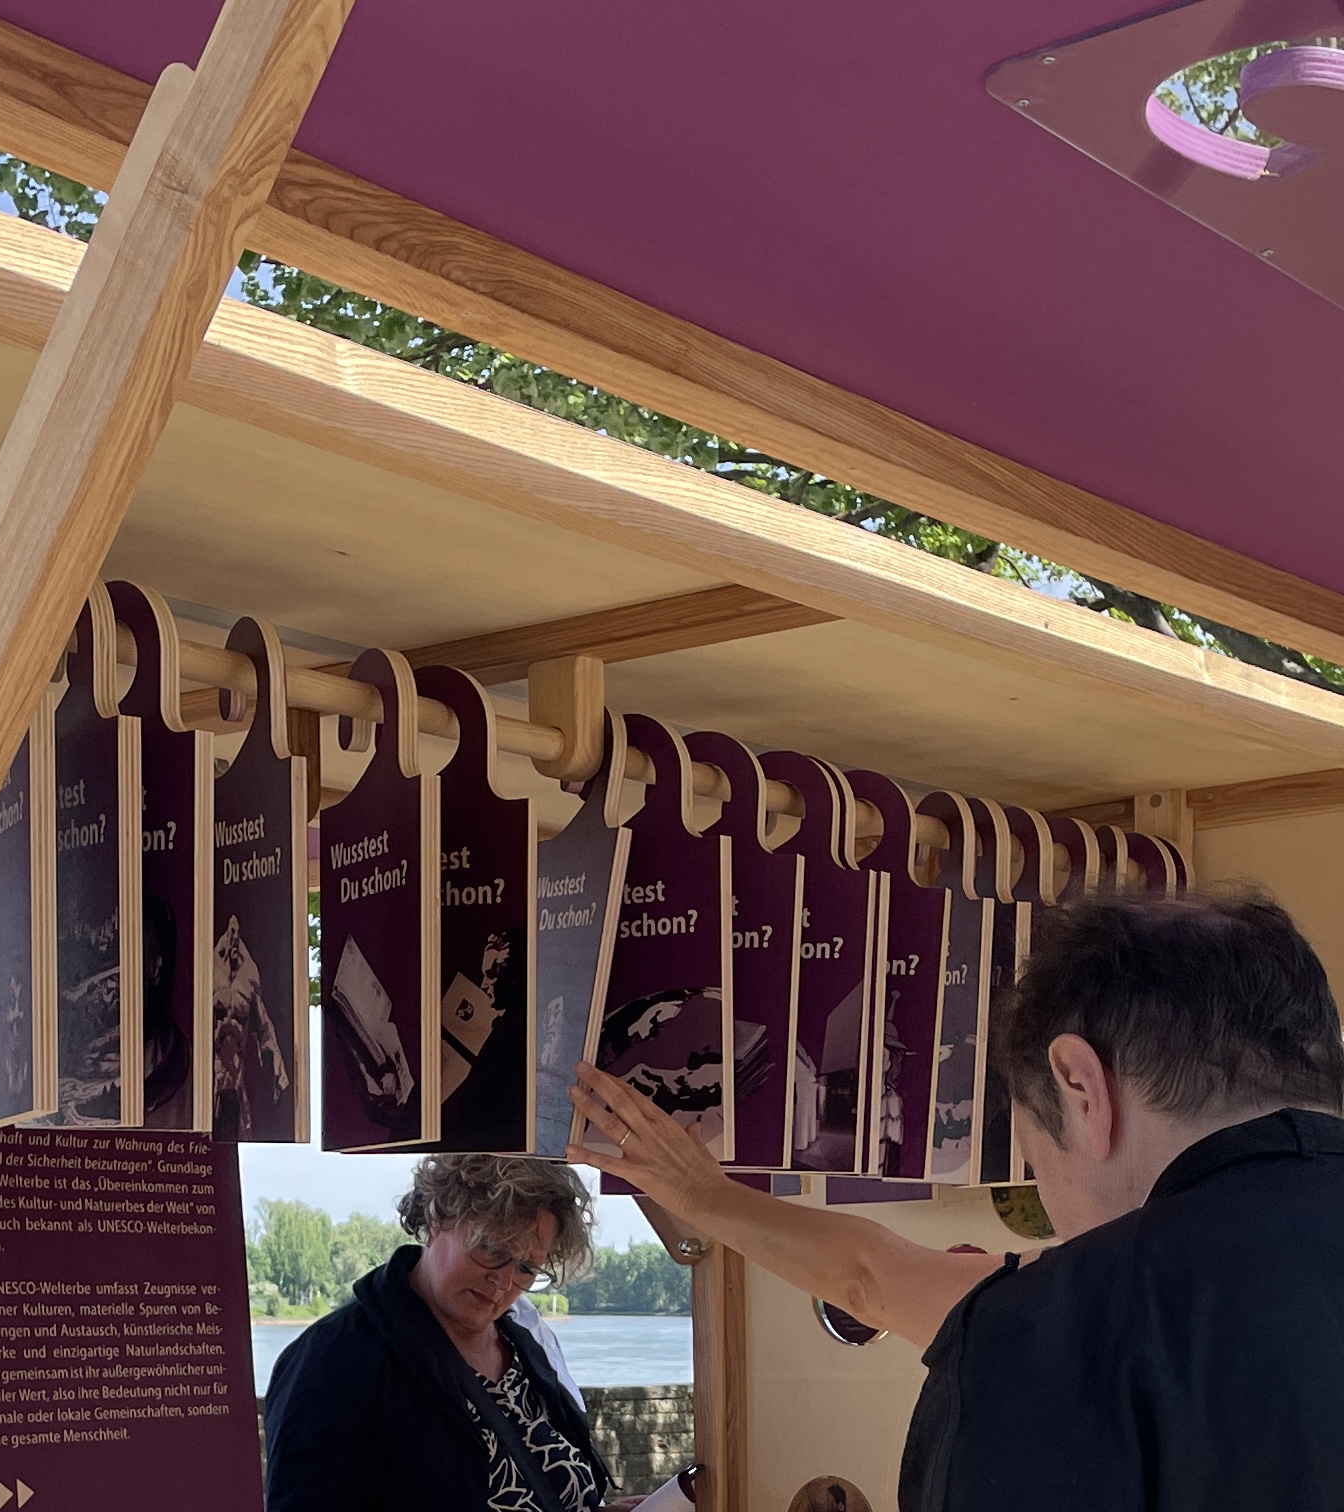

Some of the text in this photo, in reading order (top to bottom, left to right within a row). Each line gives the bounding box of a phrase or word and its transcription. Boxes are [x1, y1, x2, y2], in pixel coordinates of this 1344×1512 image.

[59, 778, 86, 810] test
[215, 813, 265, 848] Wusstest
[330, 829, 389, 870] Wusstest
[223, 847, 282, 885] Du schon?
[340, 859, 408, 904] Du schon?
[537, 872, 586, 900] Wusstest
[623, 880, 666, 905] test
[539, 902, 597, 931] Du schon?
[620, 909, 698, 939] schon?
[28, 1132, 51, 1147] und
[54, 1133, 89, 1148] Kultur
[92, 1138, 111, 1149] zur
[114, 1136, 163, 1156] Wahrung
[166, 1139, 185, 1154] des
[188, 1140, 212, 1155] Frie-
[24, 1216, 74, 1232] bekannt
[76, 1218, 94, 1233] als
[96, 1218, 216, 1235] UNESCO-Welterbekon-
[95, 1280, 139, 1295] umfasst
[143, 1281, 197, 1299] Zeugnisse
[200, 1284, 221, 1295] ver-
[33, 1322, 57, 1337] und
[60, 1322, 121, 1338] Austausch,
[122, 1321, 194, 1336] künstlerische
[195, 1321, 224, 1335] Meis-
[22, 1344, 47, 1359] und
[52, 1344, 120, 1361] einzigartige
[125, 1341, 226, 1357] Naturlandschaften.
